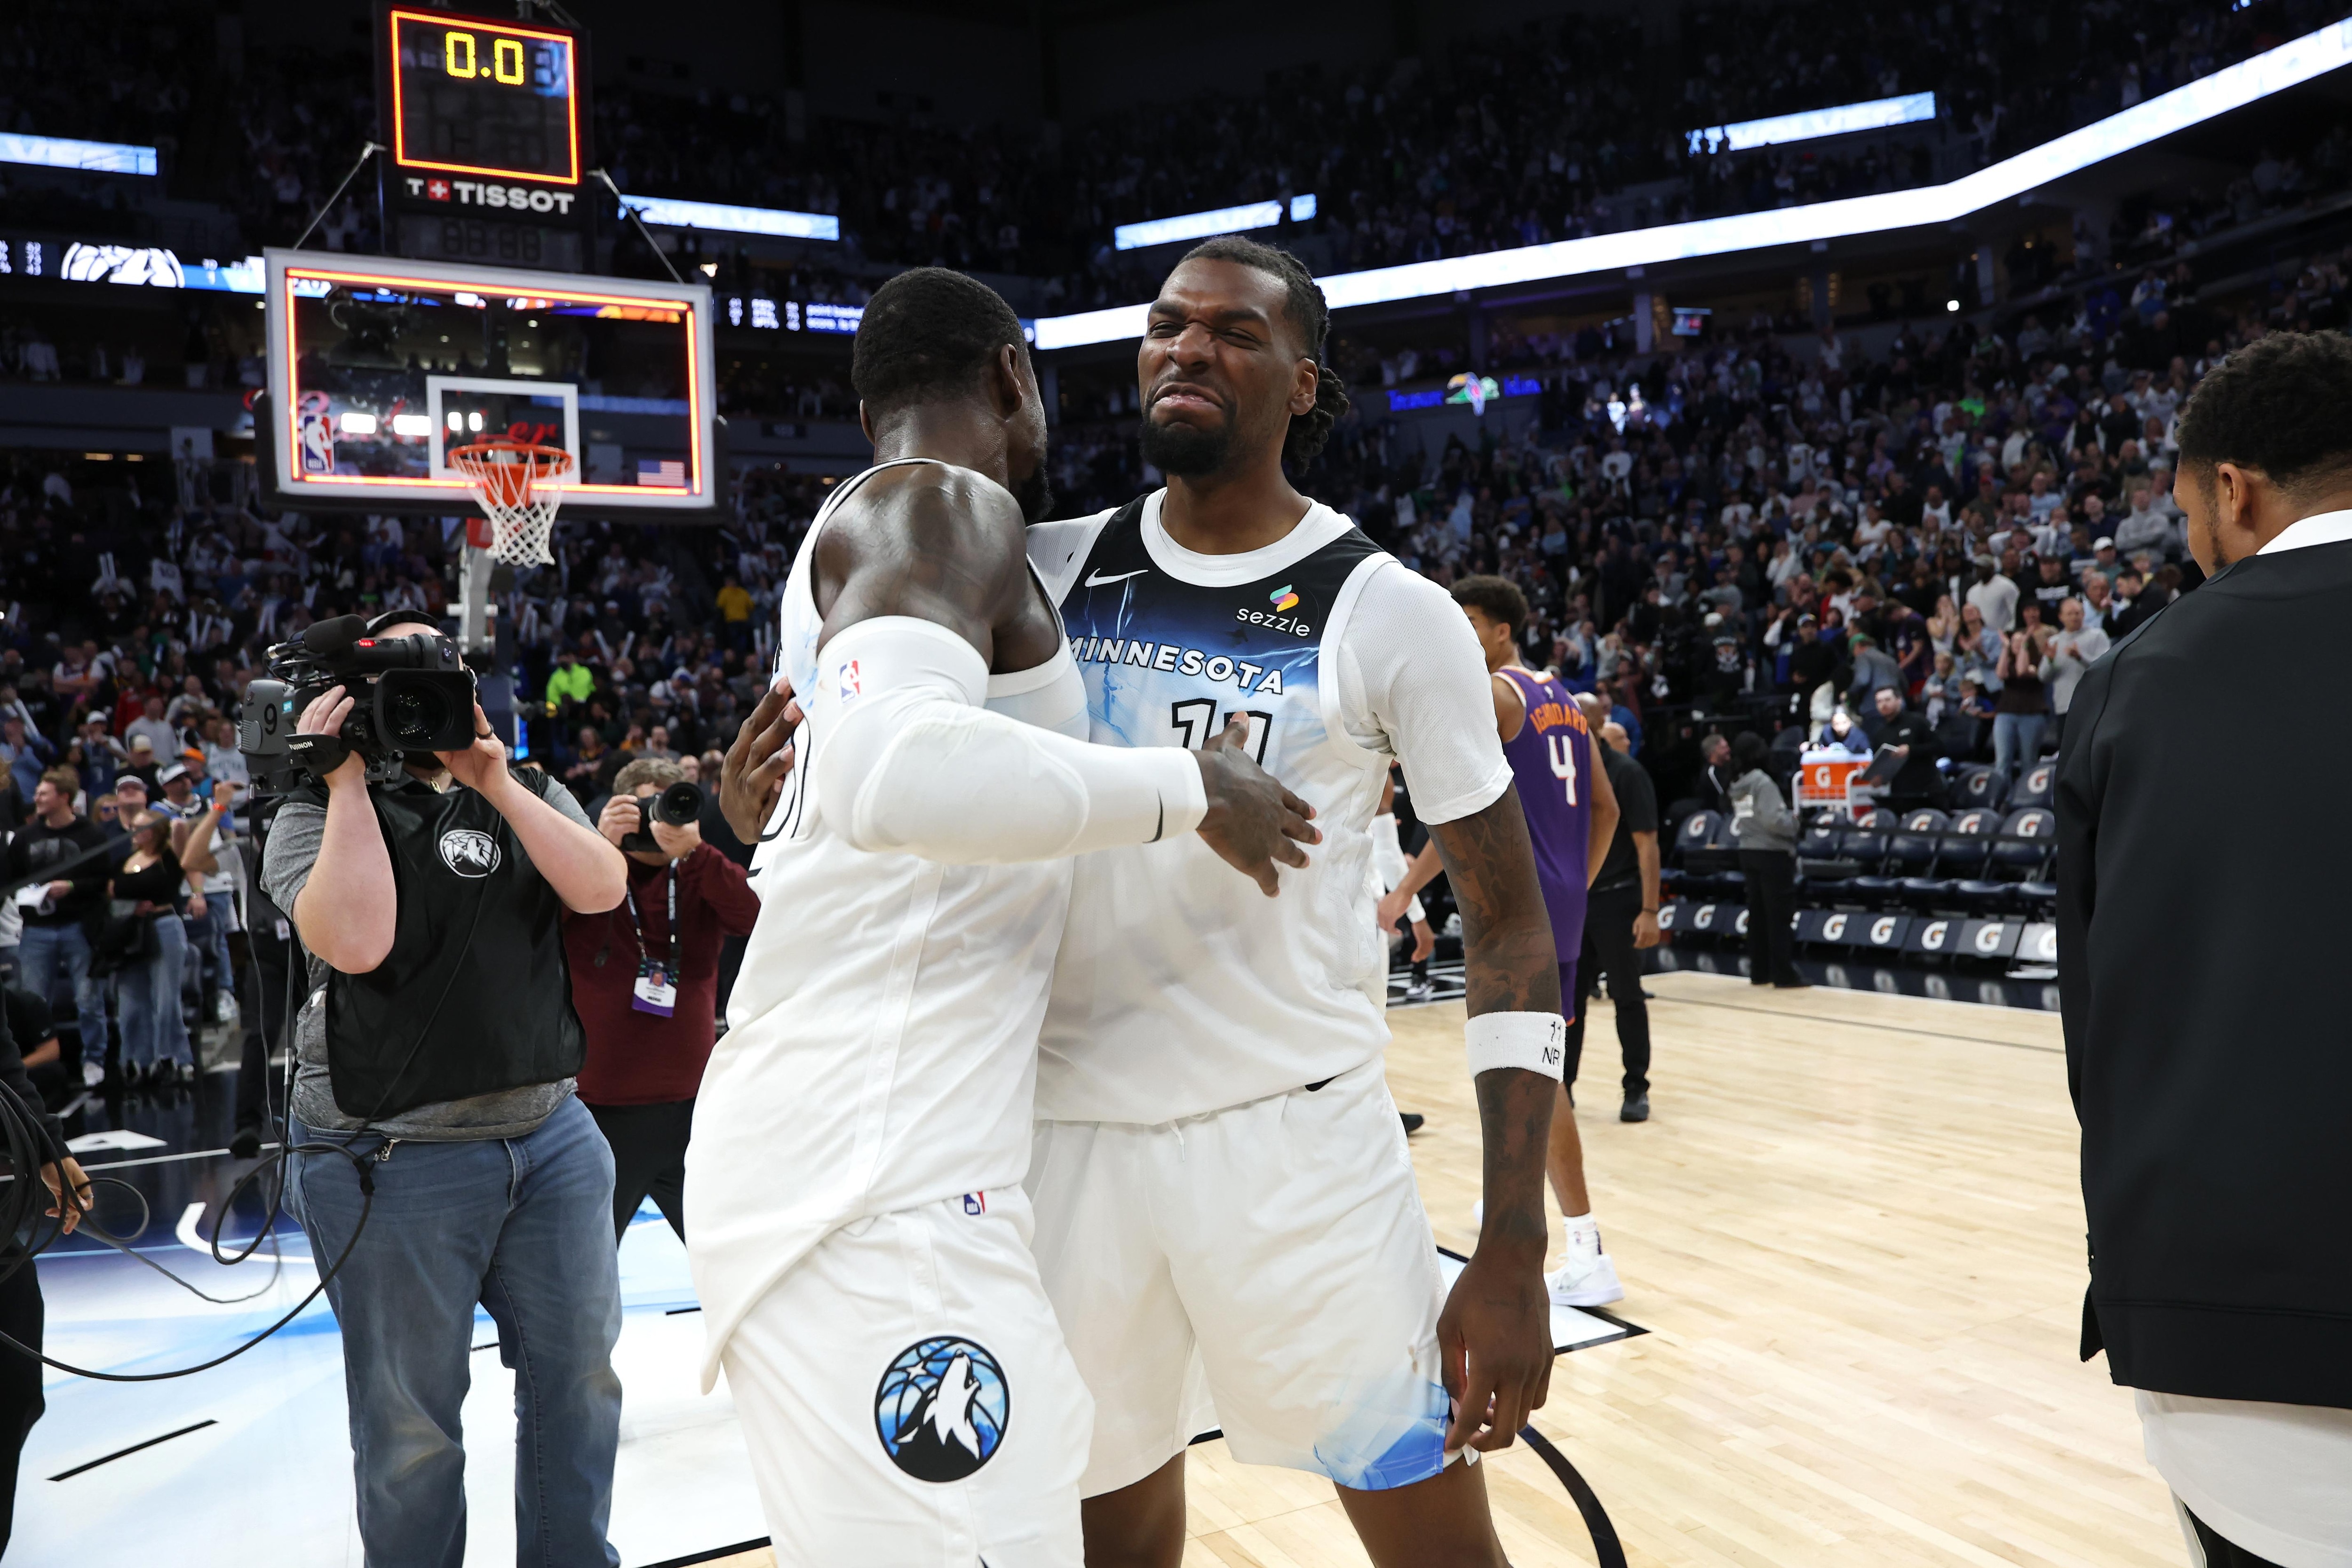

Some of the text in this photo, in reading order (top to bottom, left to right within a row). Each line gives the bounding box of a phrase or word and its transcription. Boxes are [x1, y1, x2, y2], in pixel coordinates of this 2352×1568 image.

[445, 31, 524, 85] 0.0
[453, 180, 575, 215] TISSOT
[1236, 607, 1311, 637] sezzle
[264, 703, 277, 735] 9
[288, 740, 314, 751] FUJINON
[1547, 735, 1578, 807] 4
[1815, 765, 1832, 789] G
[2027, 768, 2050, 794] G
[1688, 814, 1708, 837] G
[1657, 904, 1677, 930] G
[1694, 904, 1716, 930] G
[1823, 913, 1848, 941] G
[1870, 916, 1897, 945] G
[1921, 921, 1949, 950] G
[1975, 922, 2004, 953] G
[1542, 1046, 1560, 1067] NR
